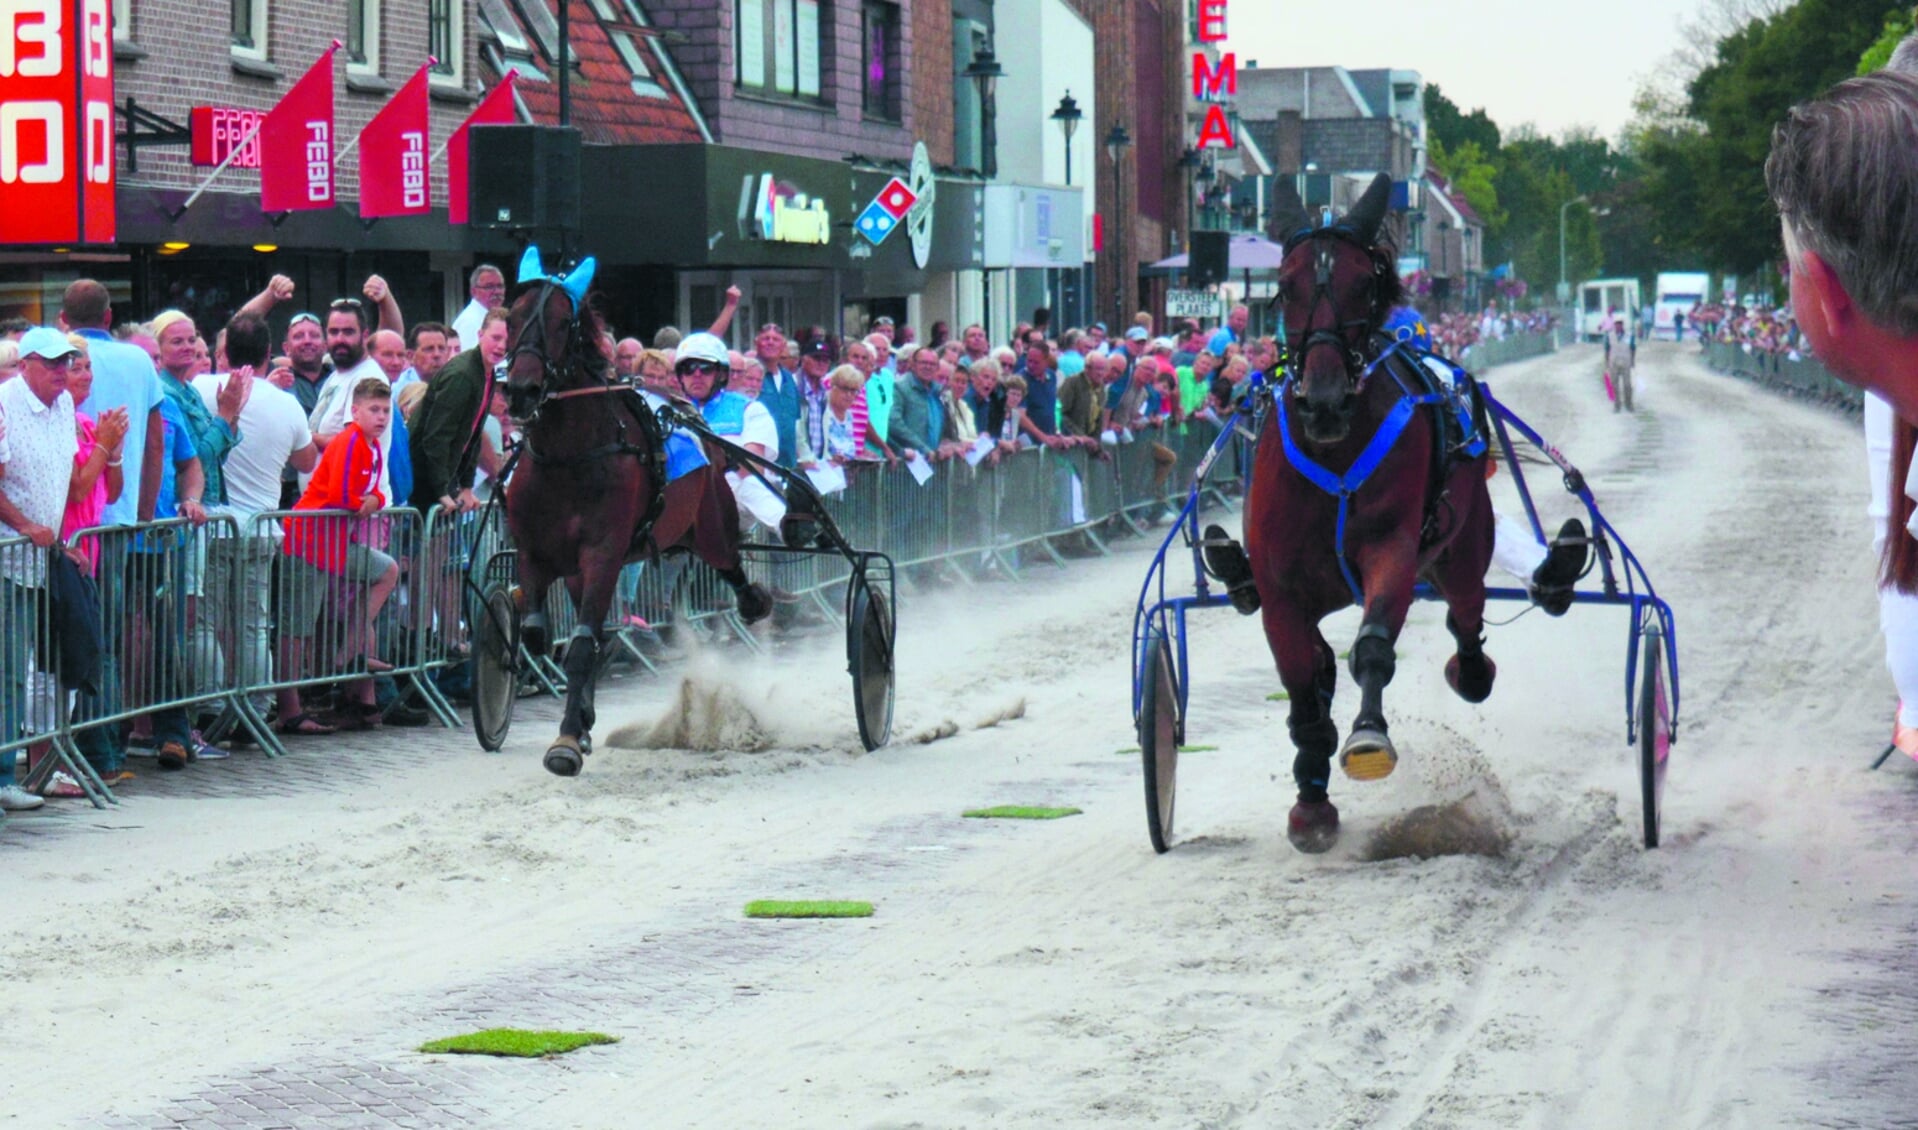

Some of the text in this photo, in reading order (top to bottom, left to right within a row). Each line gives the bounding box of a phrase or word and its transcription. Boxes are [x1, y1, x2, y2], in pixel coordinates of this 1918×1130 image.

[306, 121, 330, 201] FEBO
[402, 132, 425, 208] FEBO
[1176, 302, 1212, 315] PLAATS
